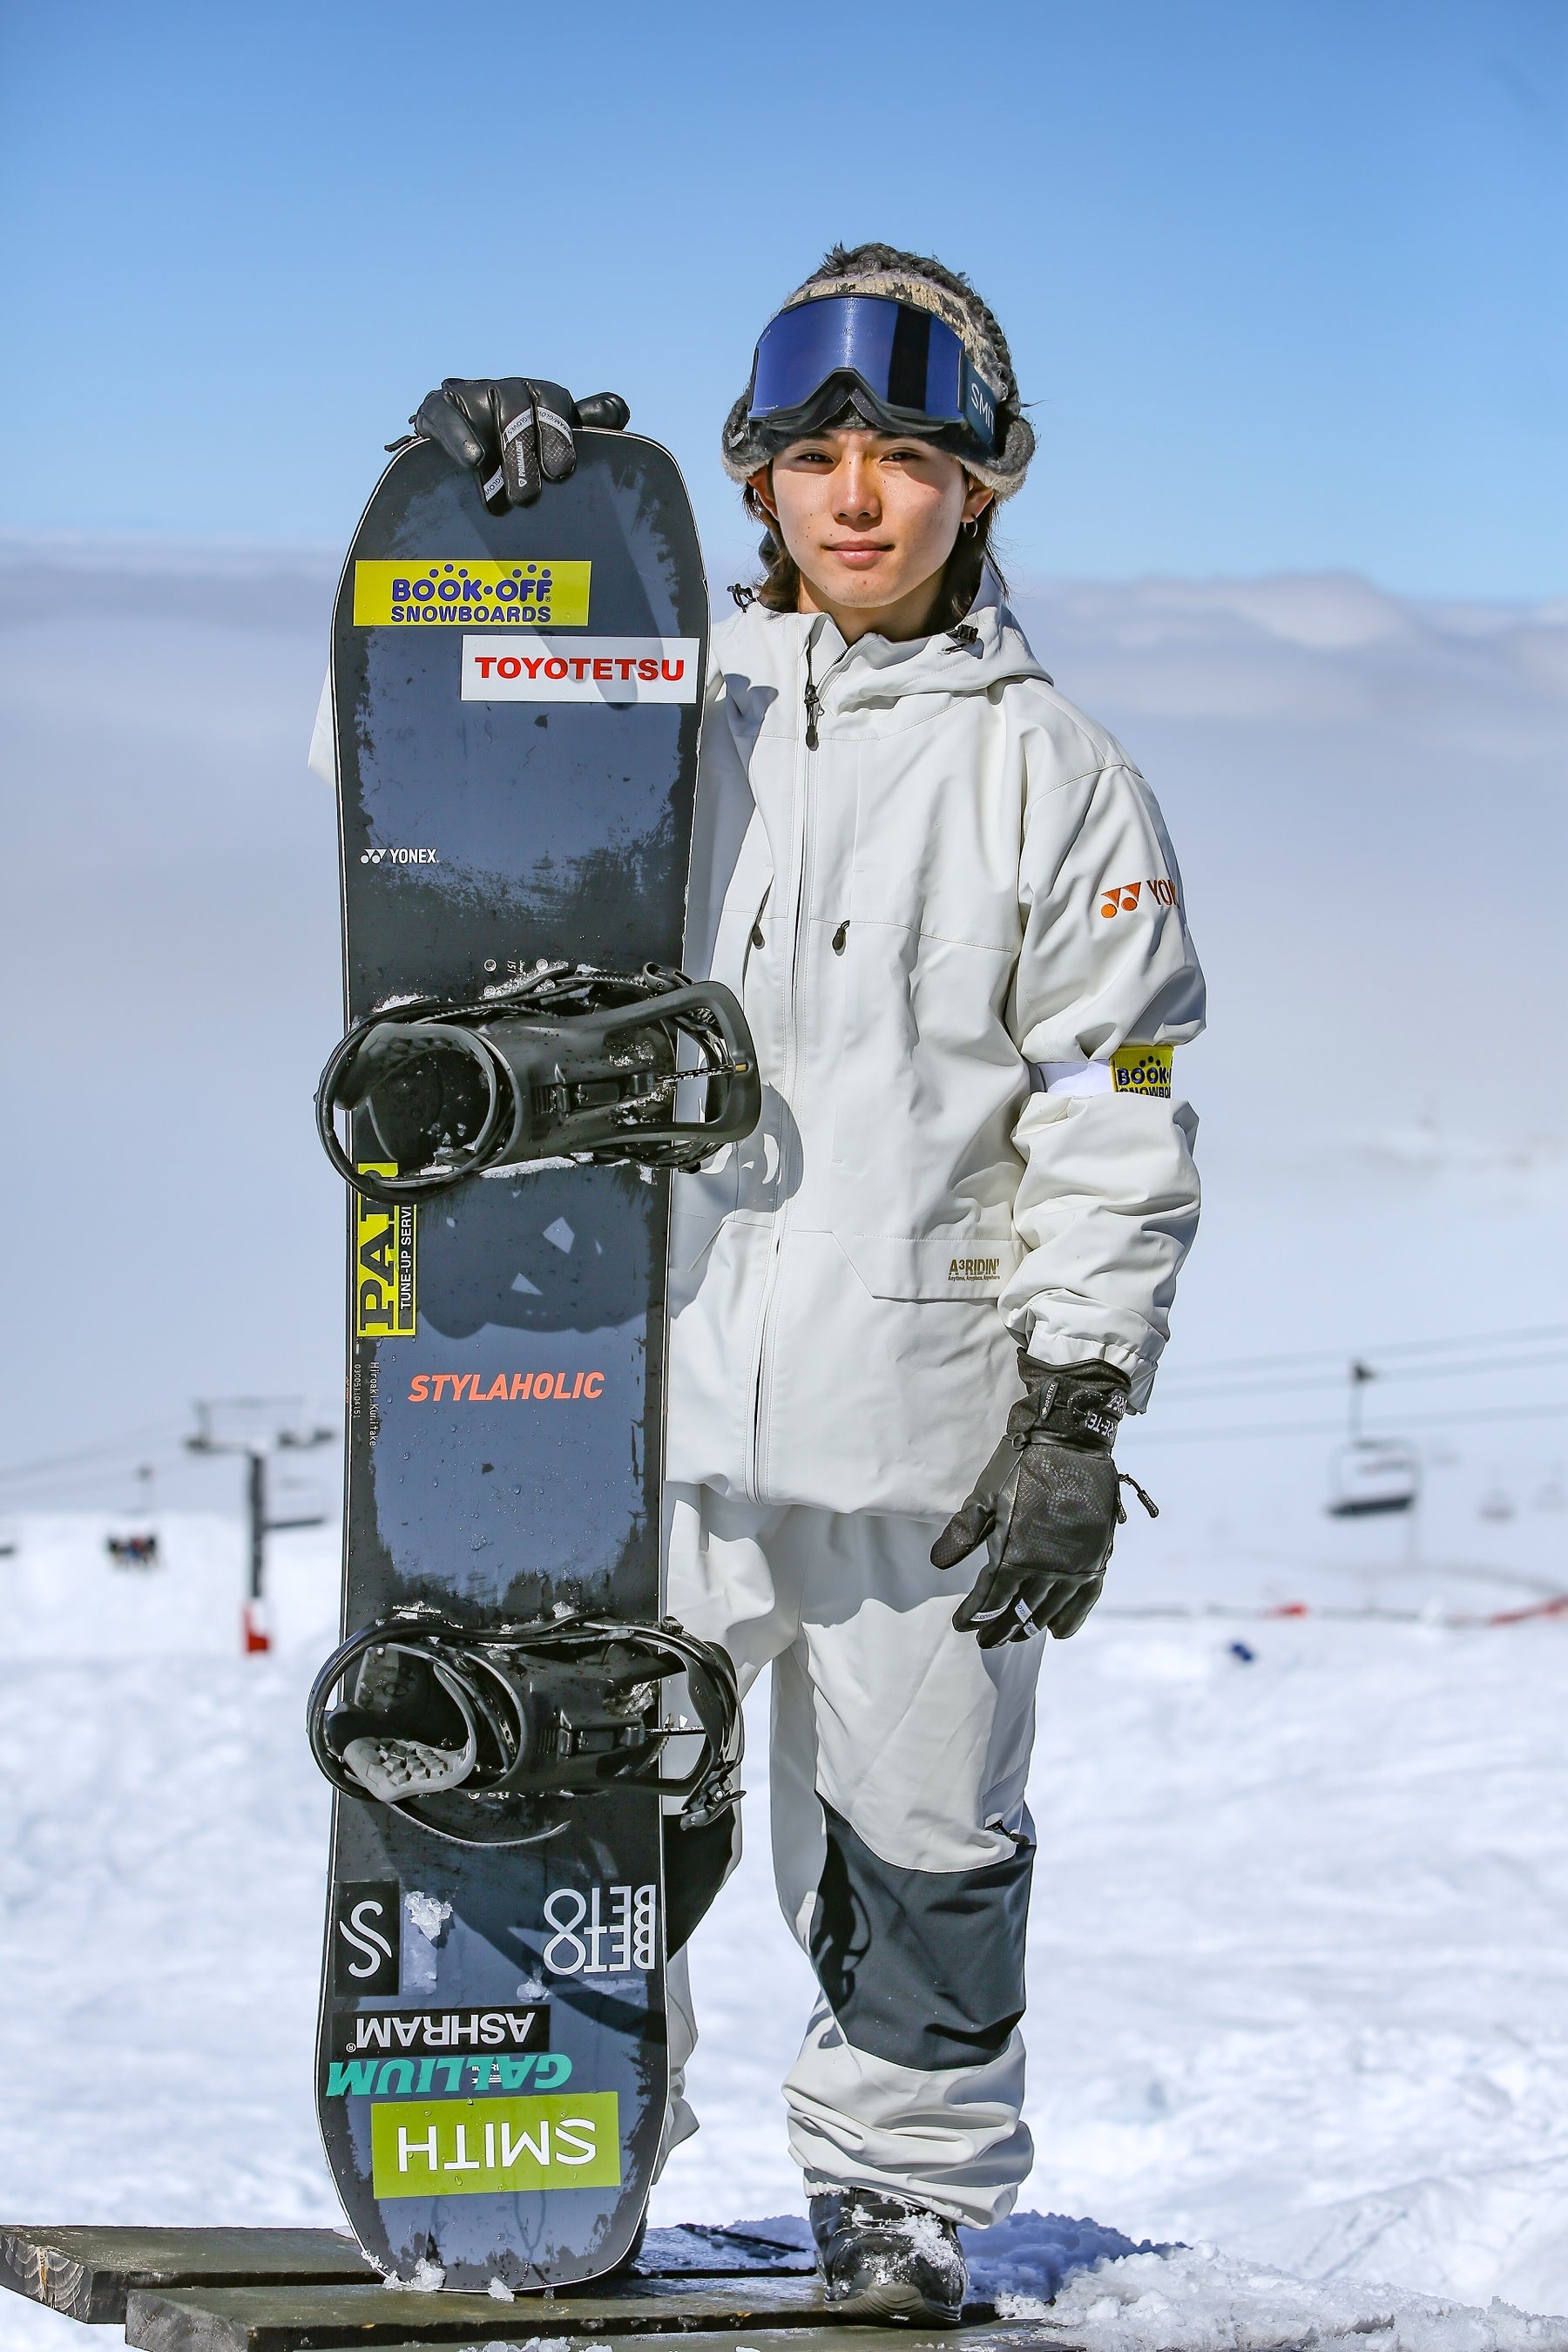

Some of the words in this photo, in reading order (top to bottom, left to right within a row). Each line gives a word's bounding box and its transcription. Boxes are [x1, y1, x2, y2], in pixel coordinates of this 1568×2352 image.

[390, 605, 552, 623] SNOWBOARDS
[474, 656, 686, 682] TOYOTETSU
[389, 848, 437, 864] YONEX
[507, 960, 517, 974] 151
[400, 1206, 412, 1247] SERVI
[400, 1250, 412, 1310] TUNE-UP
[407, 1371, 605, 1402] STYLAHOLIC
[355, 2011, 537, 2048] ASHRAM
[325, 2053, 573, 2097] GALLIUM
[397, 2118, 597, 2173] SMITH
